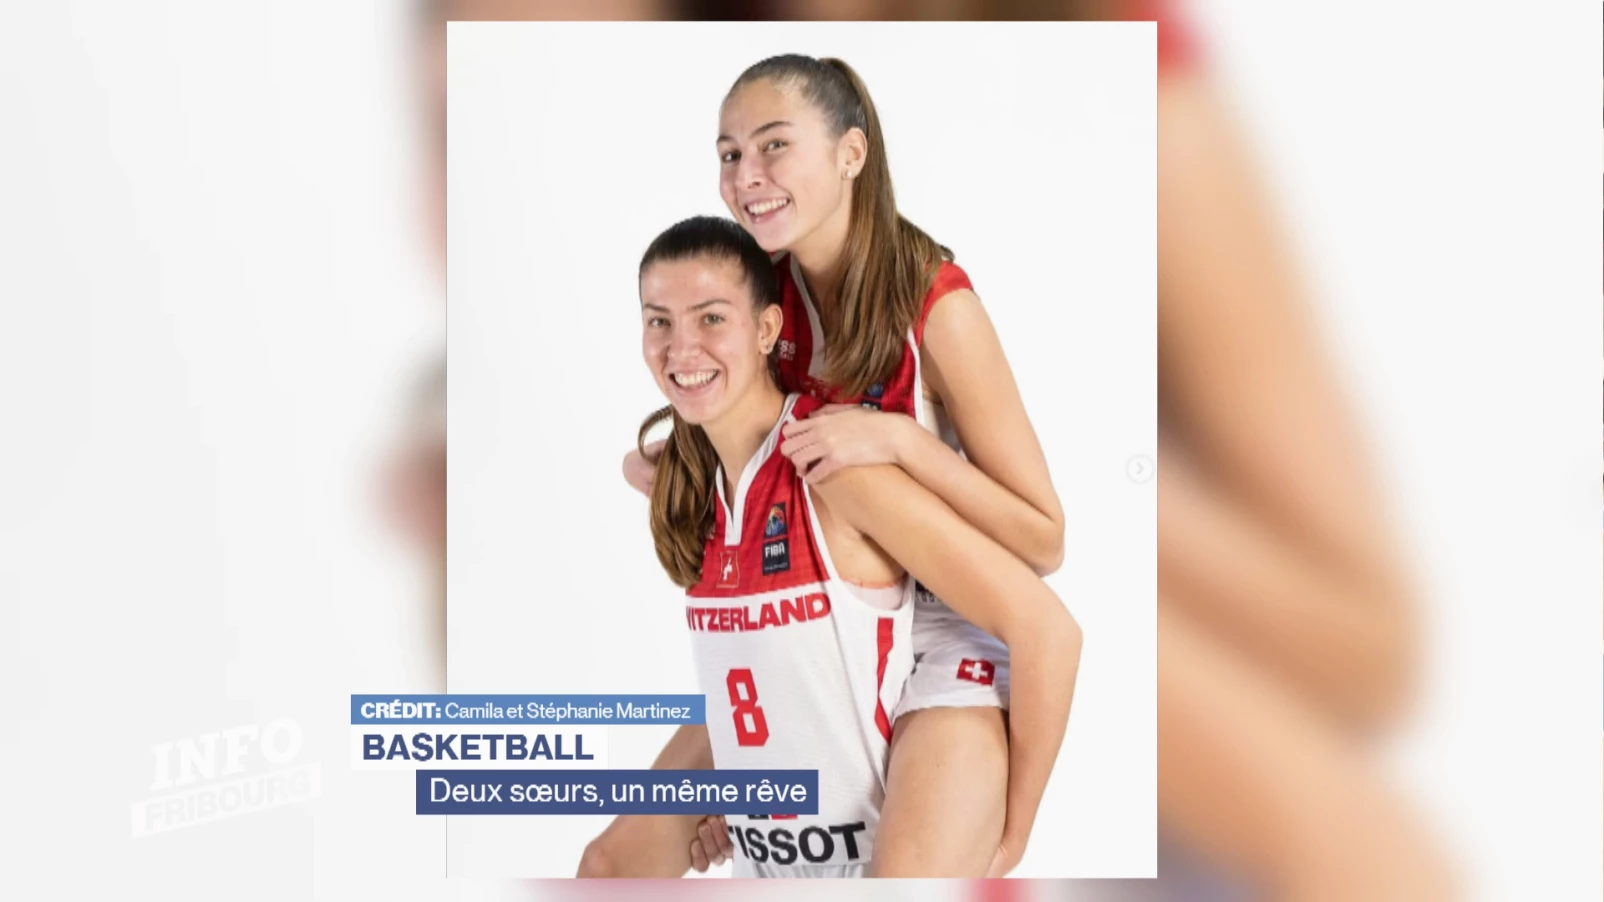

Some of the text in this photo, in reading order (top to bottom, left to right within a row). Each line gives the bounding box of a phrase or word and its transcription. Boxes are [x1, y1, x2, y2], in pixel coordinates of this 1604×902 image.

[765, 542, 785, 558] FIBA
[726, 668, 769, 747] 8
[727, 821, 866, 865] ISSOT
